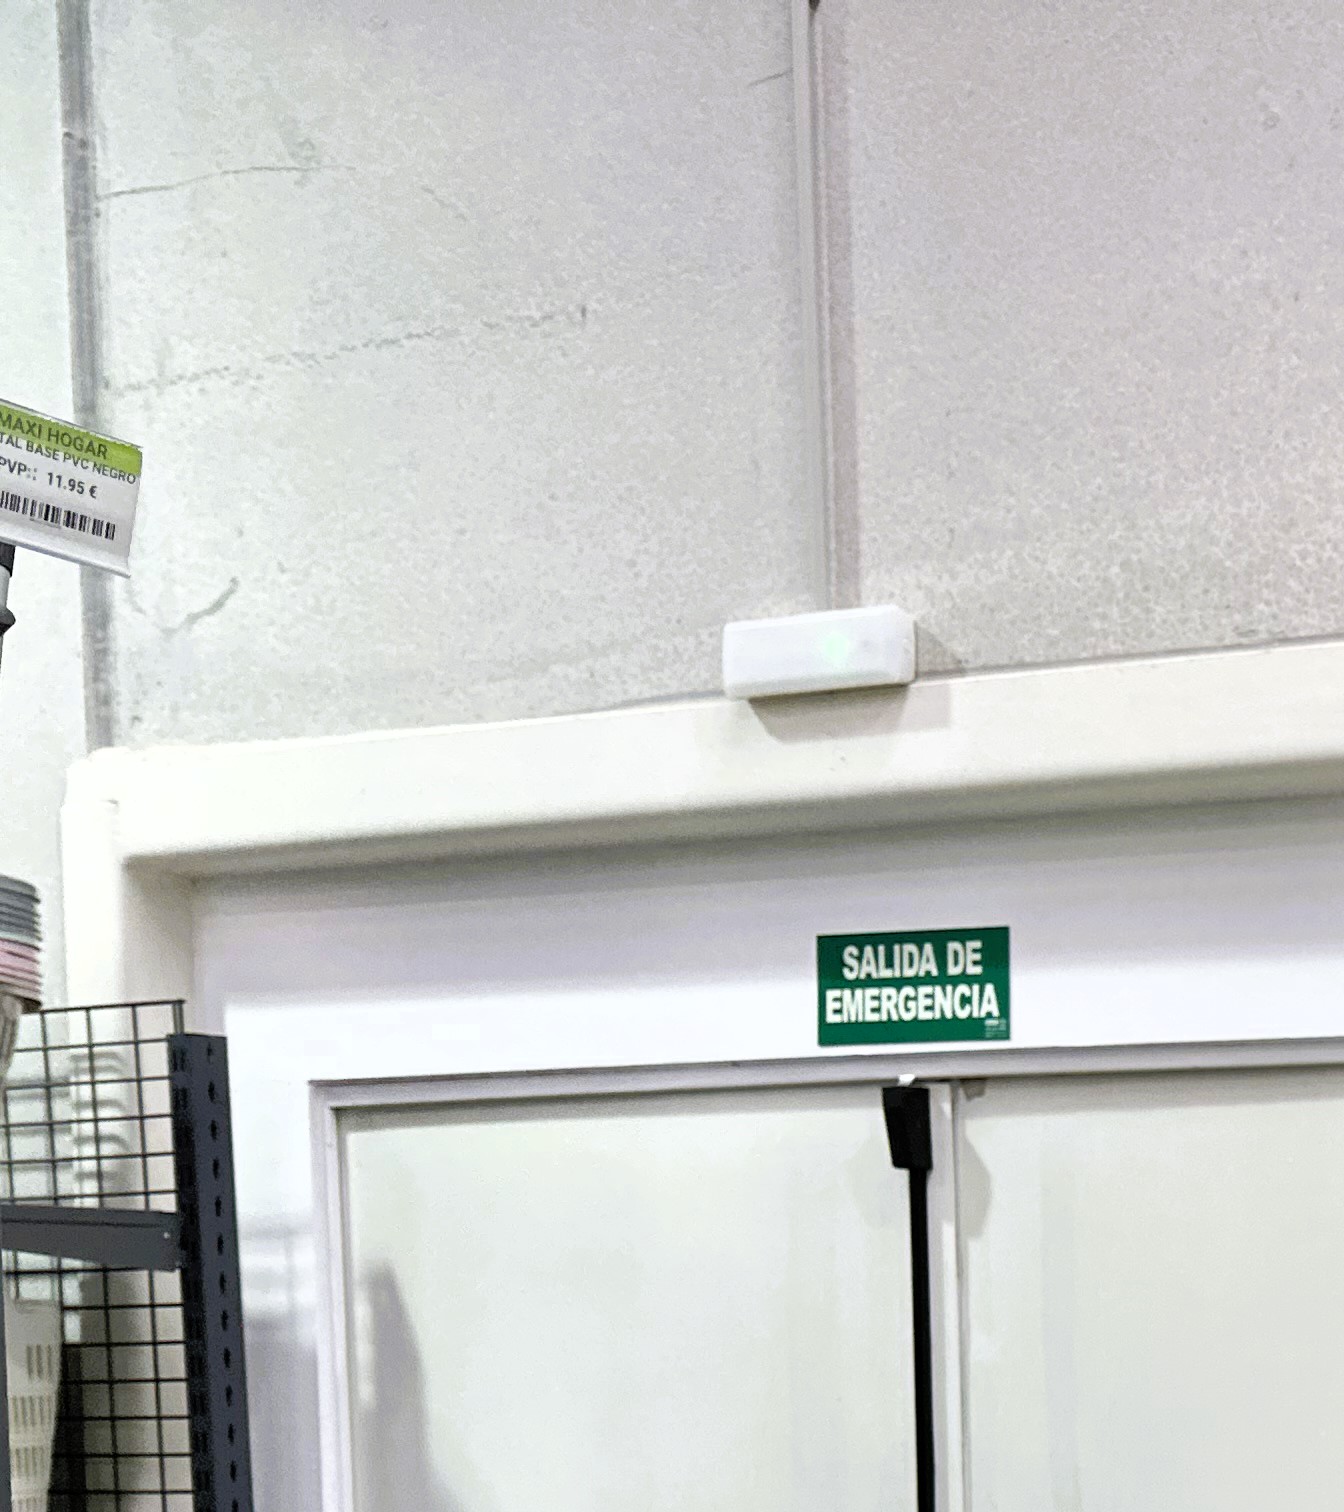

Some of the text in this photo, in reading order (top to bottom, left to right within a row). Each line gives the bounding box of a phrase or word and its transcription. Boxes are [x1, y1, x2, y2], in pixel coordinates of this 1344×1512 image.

[0, 411, 108, 460] MAXI HOGAR
[26, 440, 60, 461] BASE
[63, 450, 89, 470] PVC
[92, 461, 137, 484] NEGRO
[47, 472, 85, 495] 11.95
[89, 485, 98, 499] €
[842, 940, 983, 981] SALIDA DE
[825, 983, 1000, 1024] EMERGENCIA
